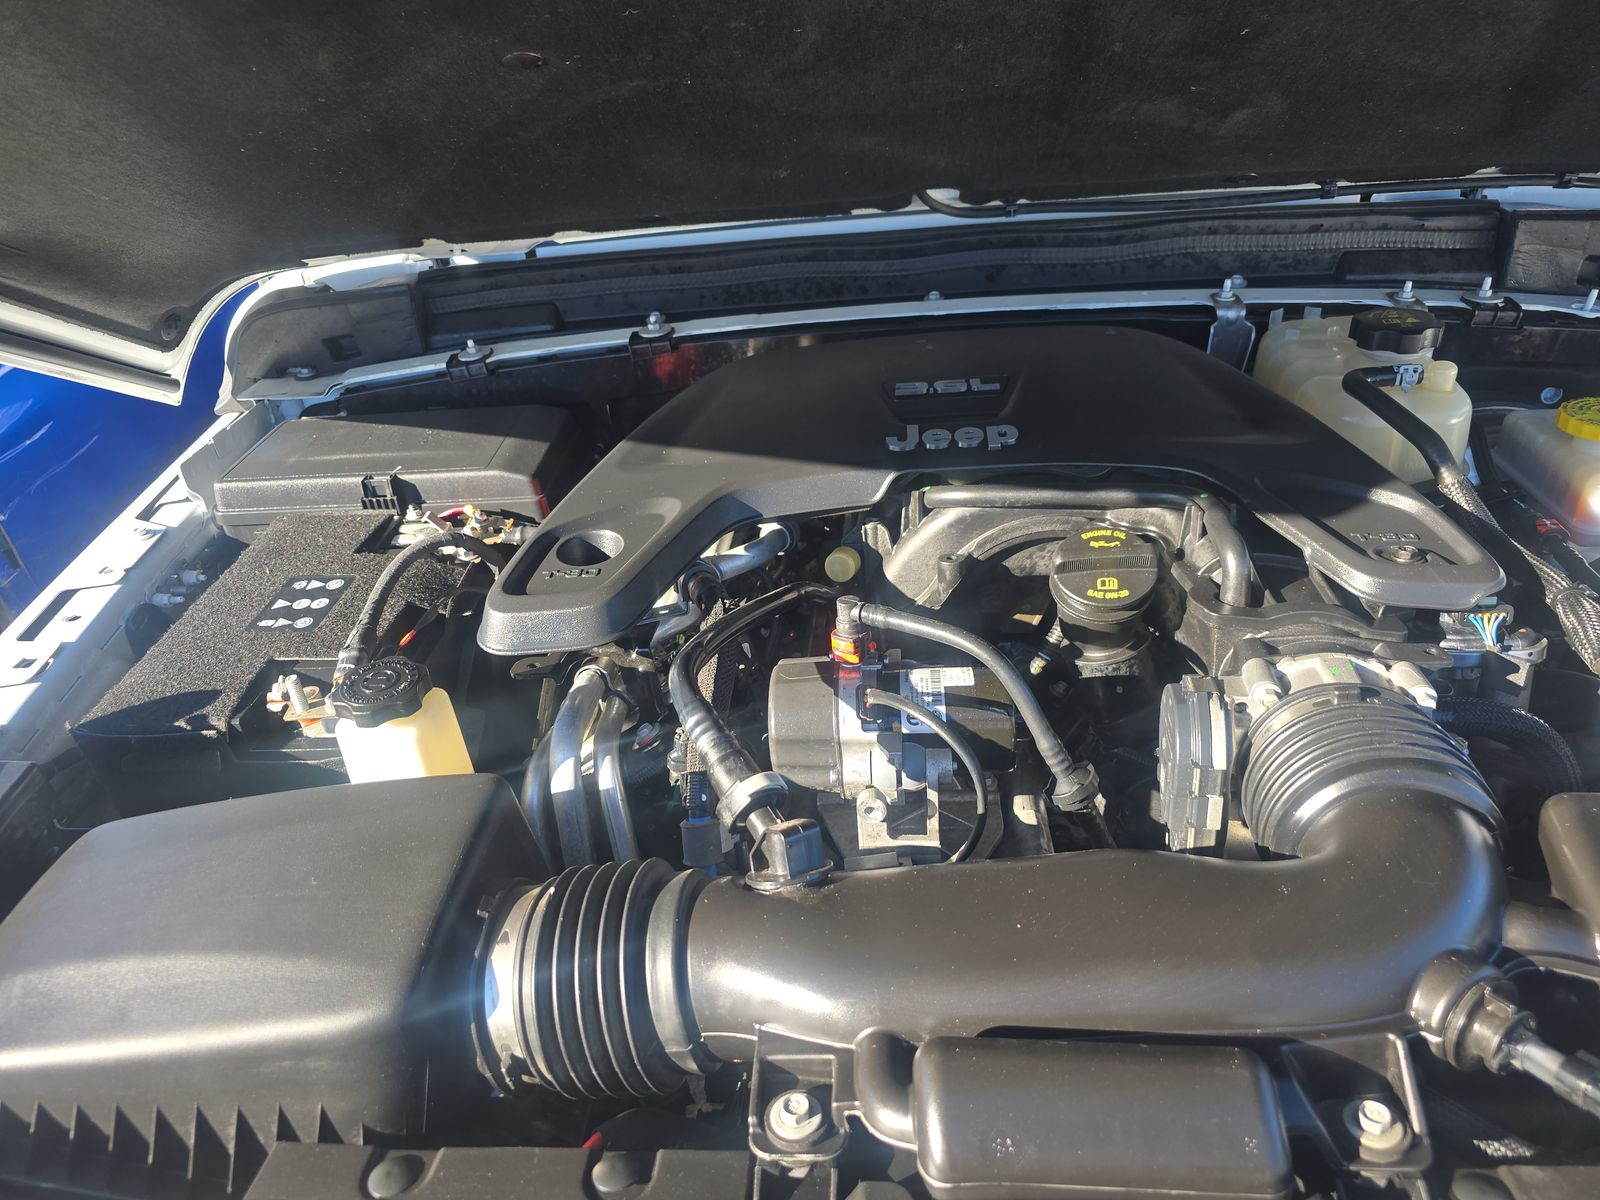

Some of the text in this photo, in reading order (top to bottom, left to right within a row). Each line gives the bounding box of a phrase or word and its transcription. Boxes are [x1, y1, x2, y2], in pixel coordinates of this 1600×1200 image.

[894, 377, 1001, 396] 3.6L
[885, 424, 1019, 451] Jeep
[1080, 529, 1127, 540] ENGINE OIL
[1086, 589, 1130, 600] SAE 0W-20
